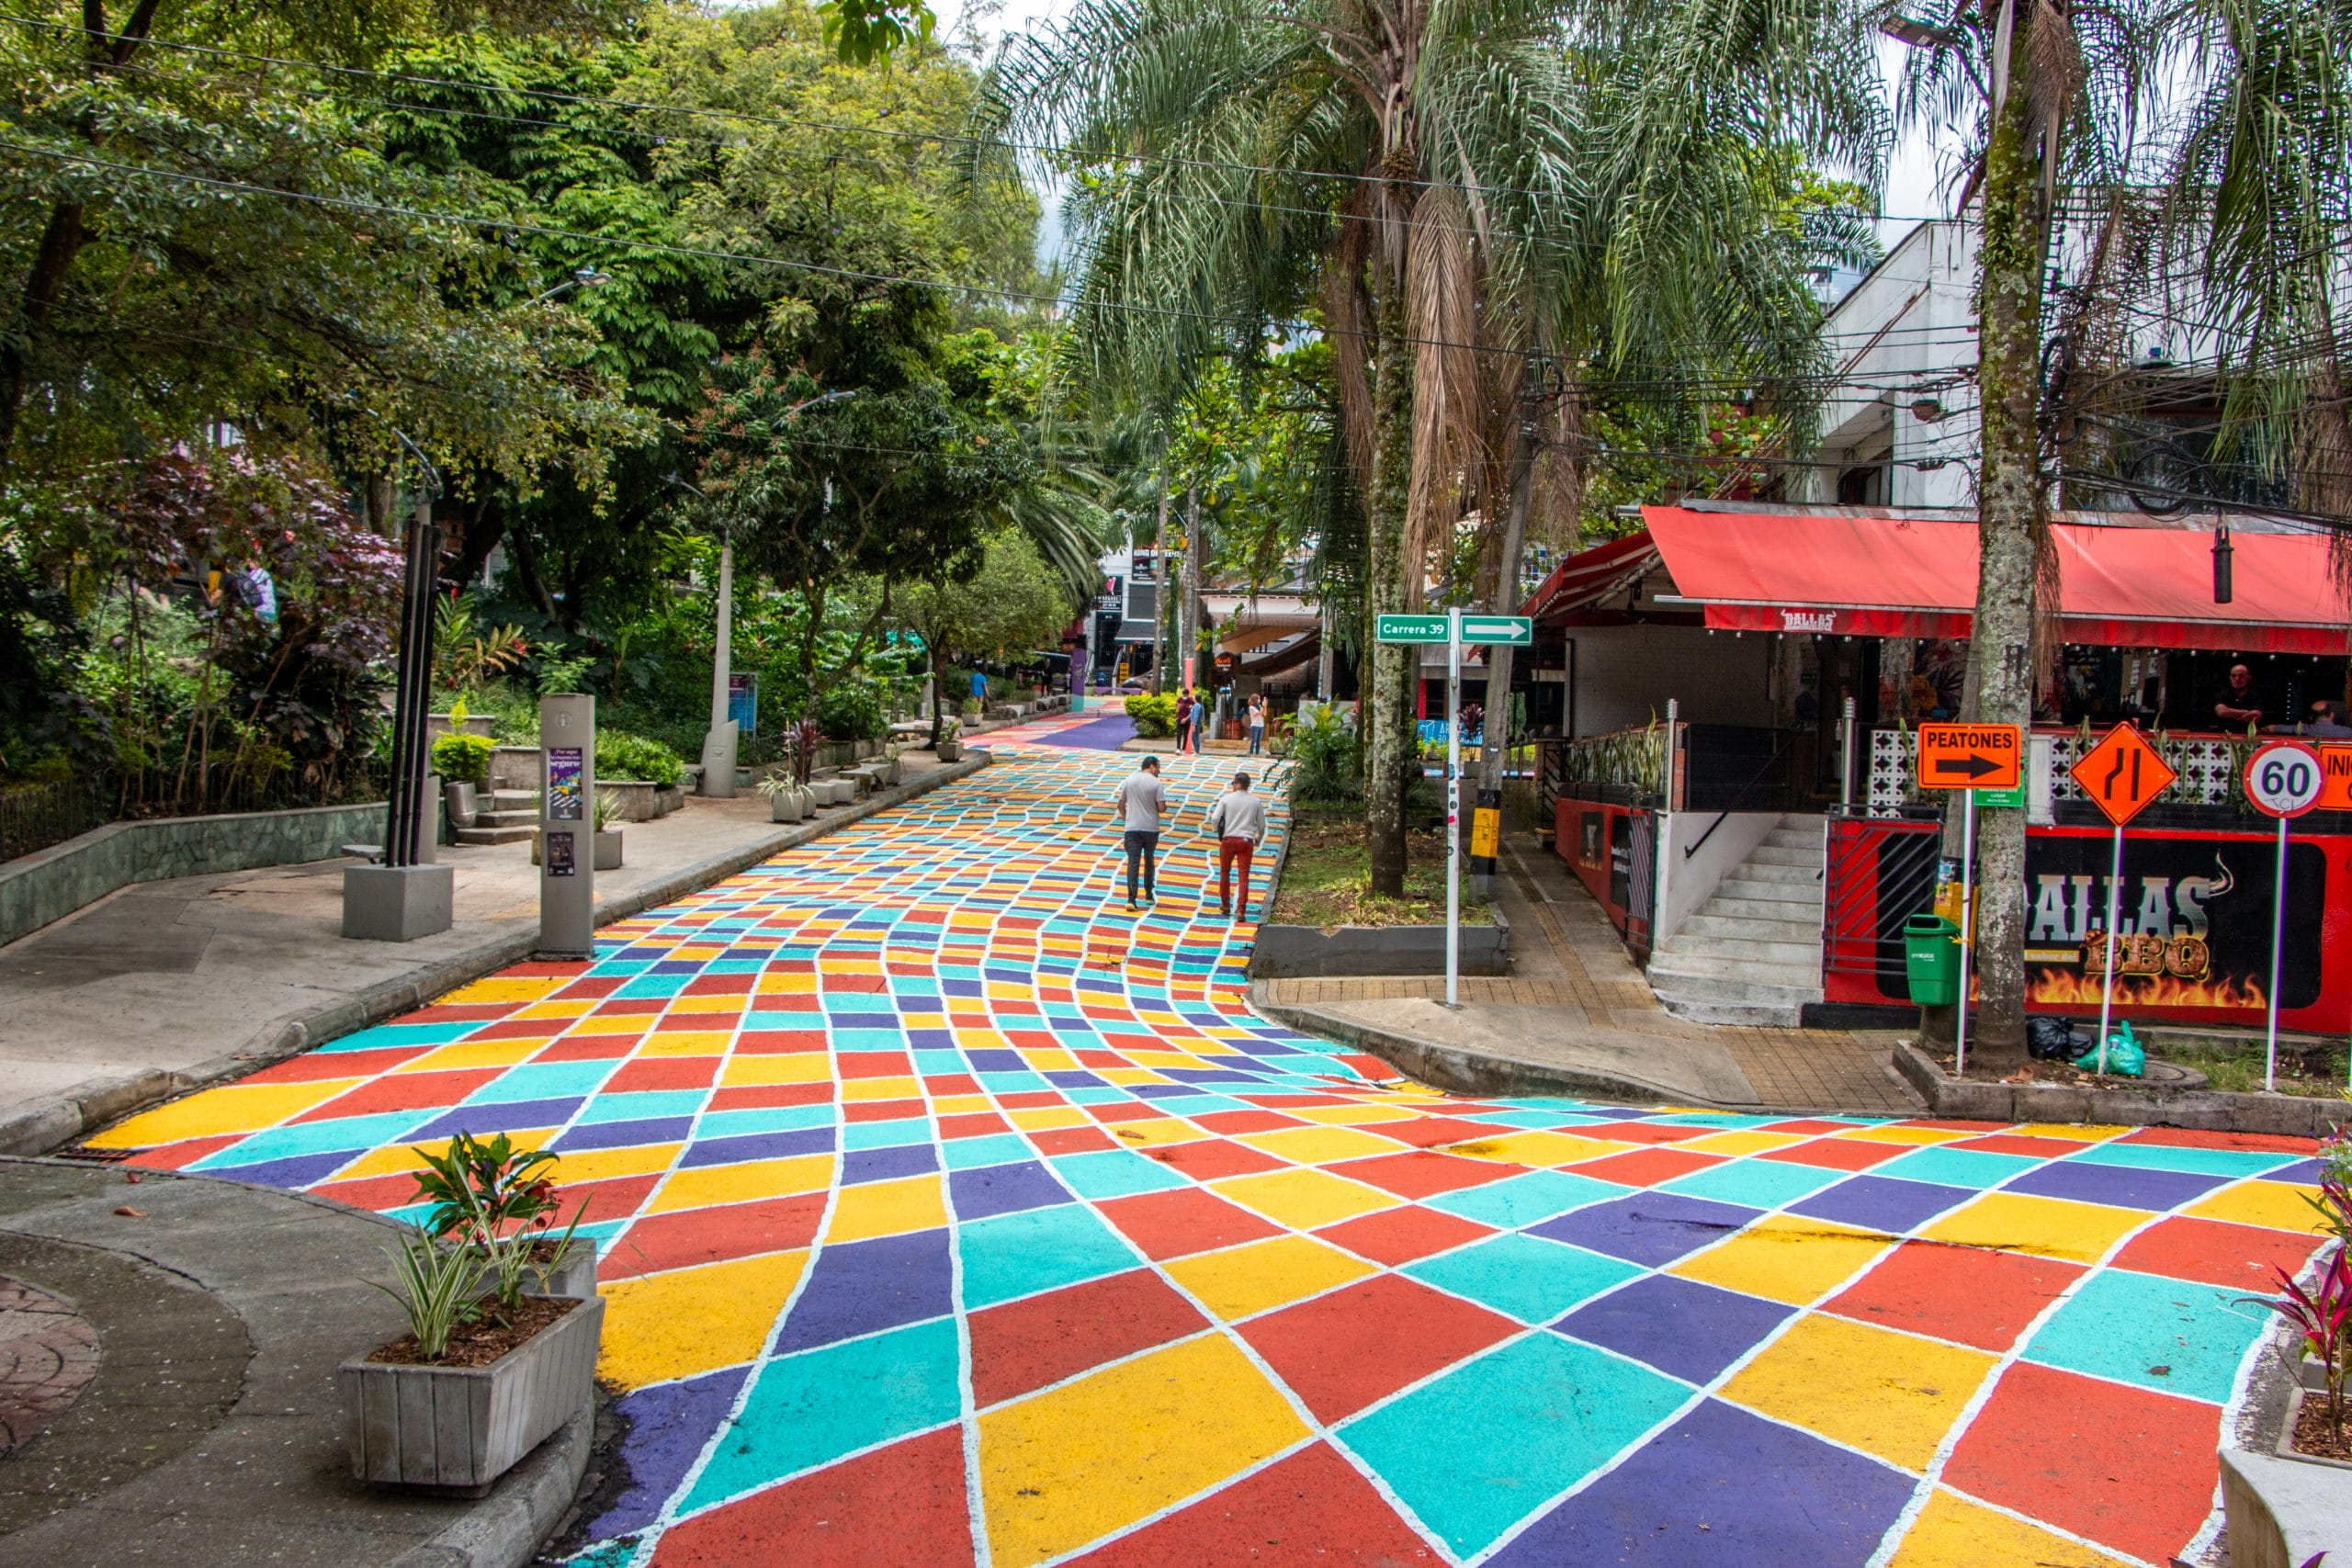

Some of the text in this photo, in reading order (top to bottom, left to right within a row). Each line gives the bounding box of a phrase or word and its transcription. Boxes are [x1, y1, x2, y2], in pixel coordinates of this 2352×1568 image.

[1785, 612, 1834, 626] DALLAS
[1383, 623, 1445, 635] Carrera 39
[1928, 732, 2012, 749] PEATONES
[2328, 755, 2352, 776] INI
[2261, 761, 2311, 797] 60
[2024, 874, 2211, 941] ALLAS
[2030, 952, 2059, 960] sabor
[2062, 952, 2077, 960] del
[2084, 934, 2211, 982] BBQ
